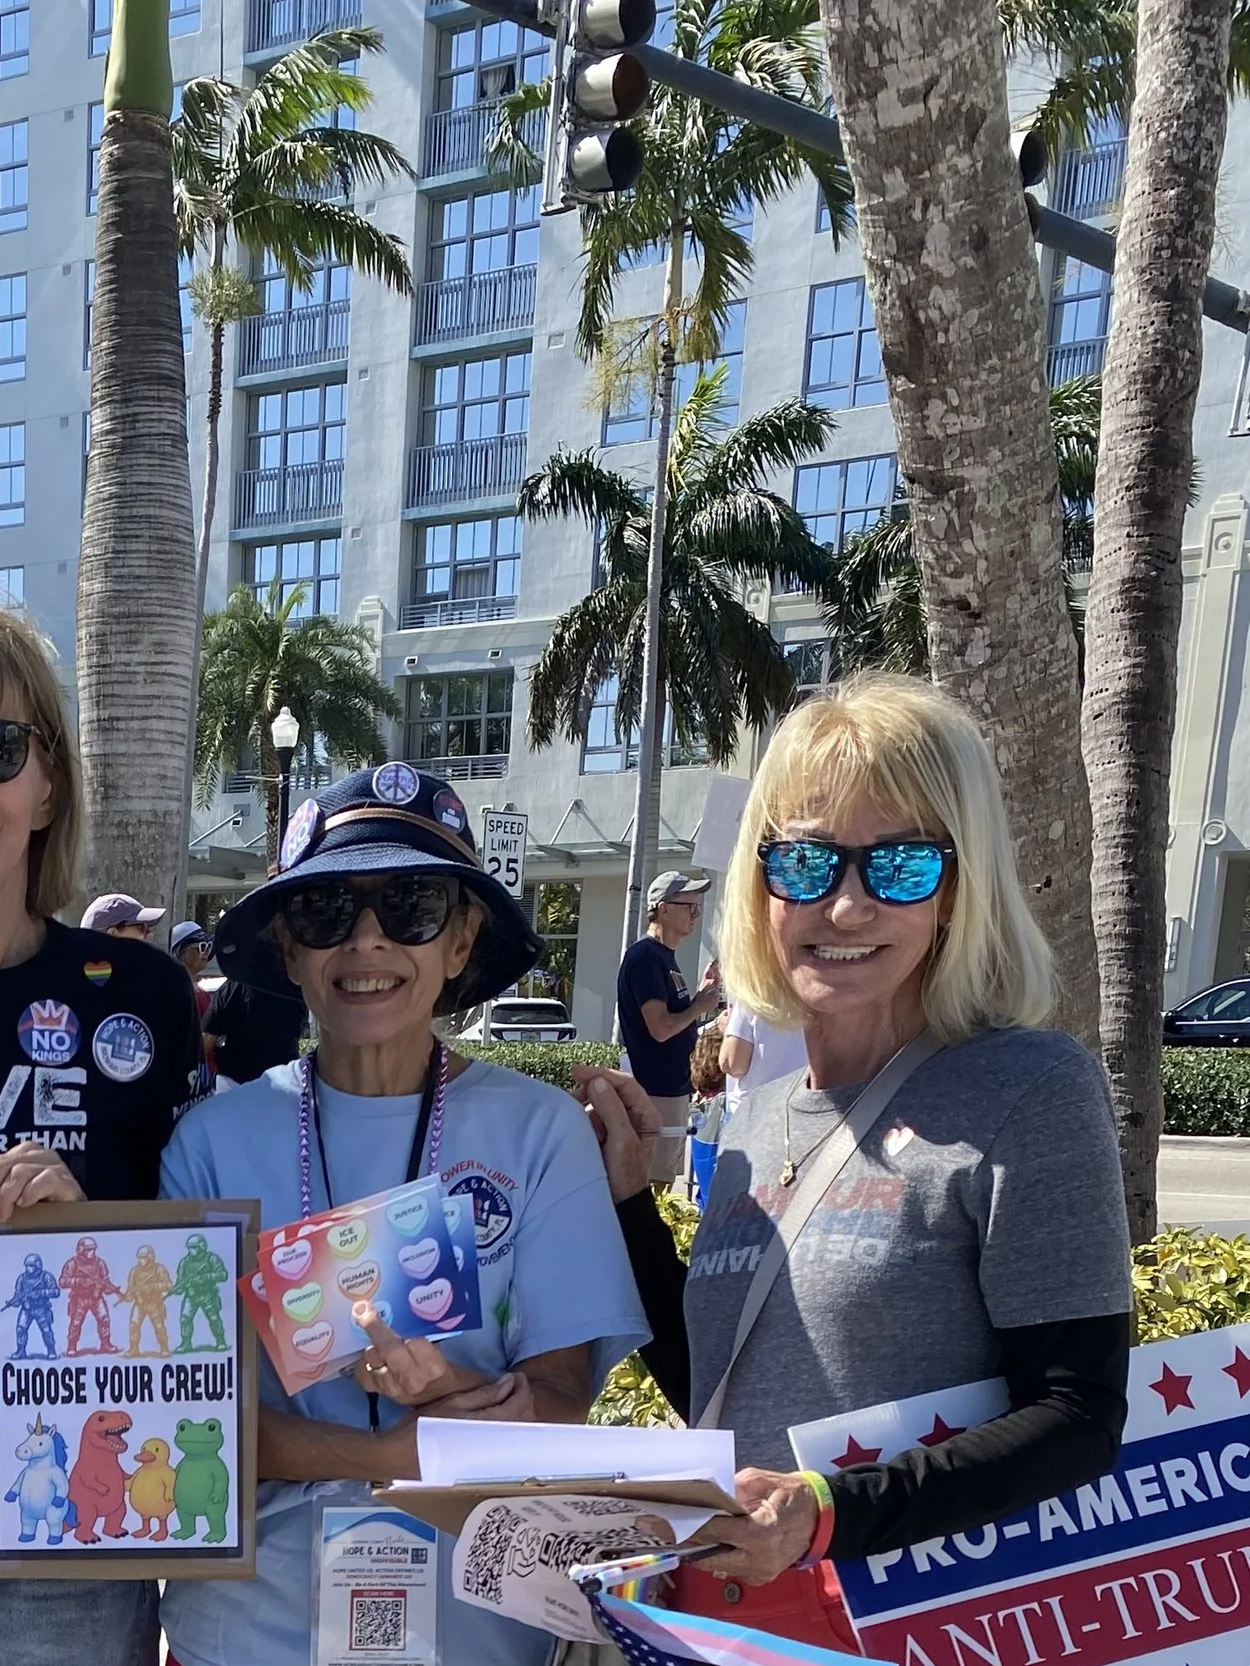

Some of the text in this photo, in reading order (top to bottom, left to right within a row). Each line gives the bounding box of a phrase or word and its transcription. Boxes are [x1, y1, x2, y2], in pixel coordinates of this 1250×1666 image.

[488, 819, 524, 835] SPEED
[491, 838, 519, 853] LIMIT
[487, 856, 519, 887] 25
[32, 1031, 71, 1050] NO
[101, 1020, 120, 1040] HOPE
[129, 1020, 151, 1049] ACTION
[32, 1051, 71, 1062] KINGS
[15, 1130, 87, 1151] THAN
[440, 1160, 474, 1183] OWER
[487, 1170, 520, 1192] UNITY
[471, 1179, 478, 1189] &
[481, 1180, 509, 1212] ACTION
[393, 1203, 423, 1222] JUSTICE
[339, 1226, 354, 1239] ICE
[339, 1234, 359, 1248] OUT
[277, 1250, 307, 1266] PROCESS
[402, 1247, 436, 1264] INCLUSION
[341, 1267, 375, 1286] HUMAN
[346, 1278, 375, 1292] RIGHTS
[286, 1289, 320, 1307] DIVERSITY
[415, 1289, 444, 1304] UNITY
[295, 1331, 330, 1348] EQUALITY
[2, 1357, 233, 1406] CHOOSE YOUR CREW!
[866, 1442, 1250, 1585] PRO-AMERIC
[342, 1546, 409, 1556] HOPE & ACTION
